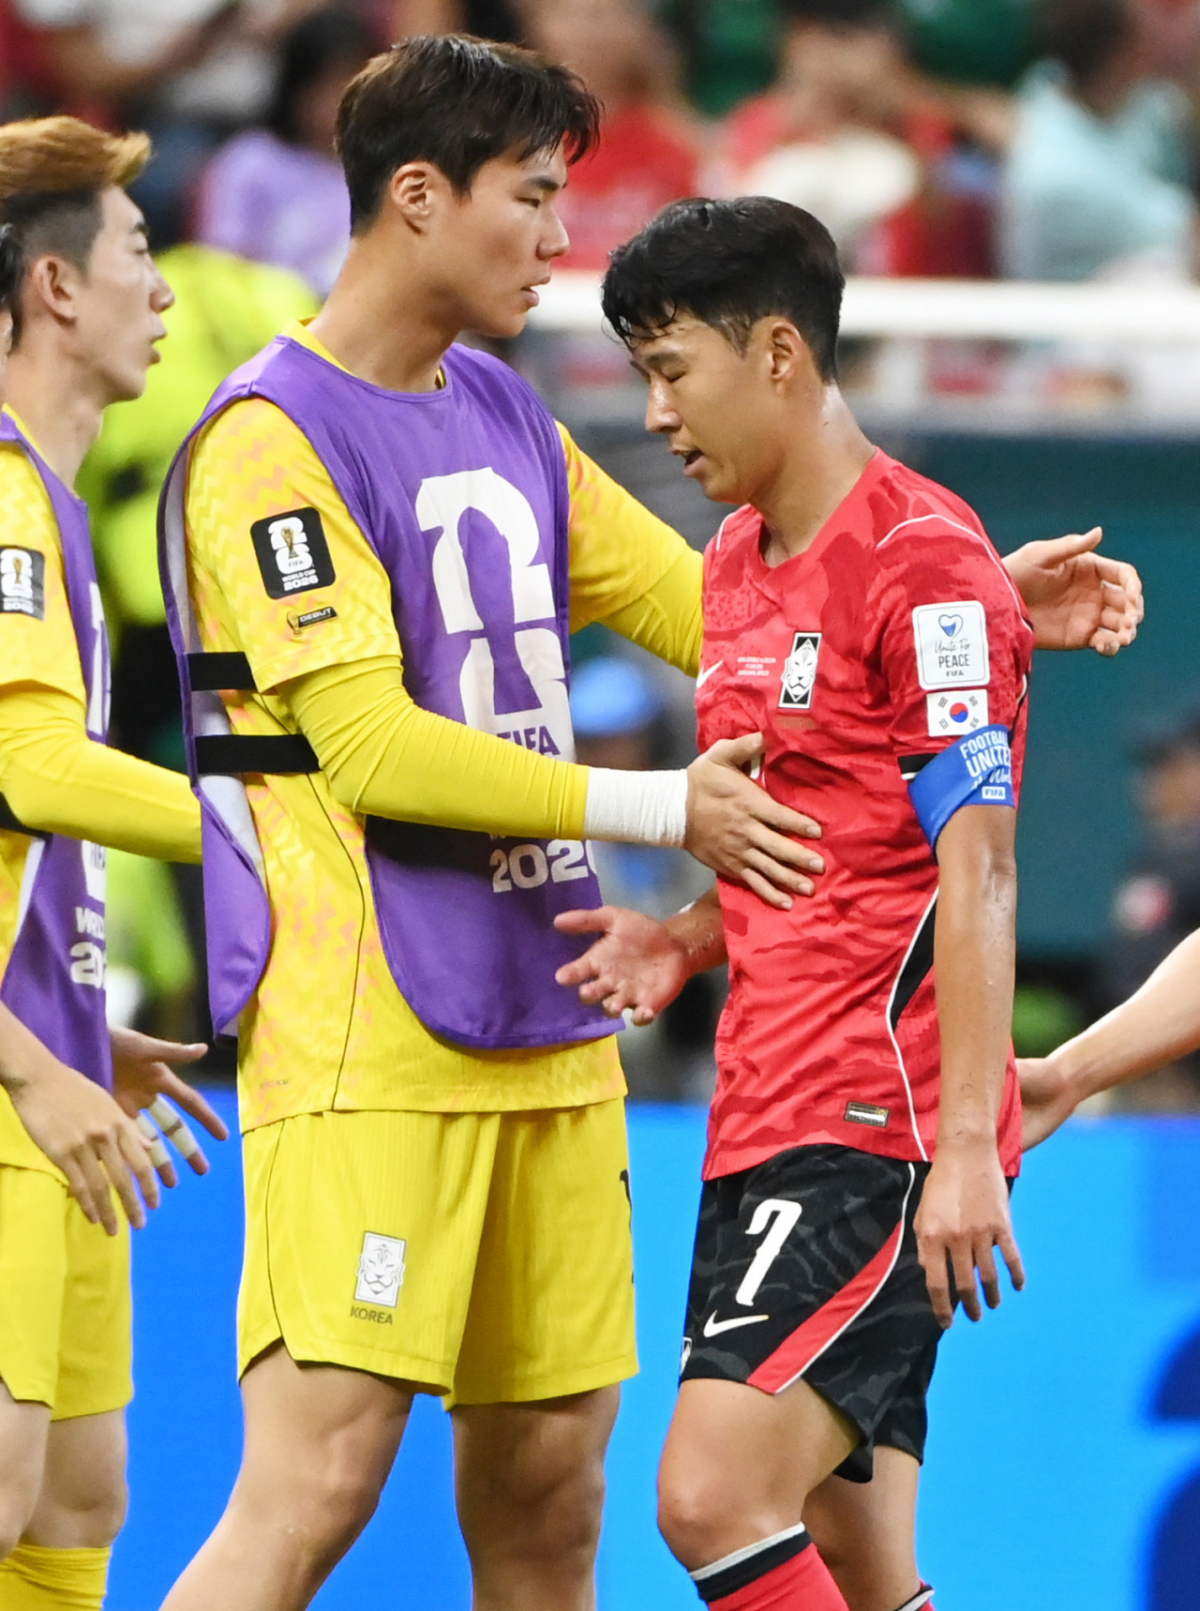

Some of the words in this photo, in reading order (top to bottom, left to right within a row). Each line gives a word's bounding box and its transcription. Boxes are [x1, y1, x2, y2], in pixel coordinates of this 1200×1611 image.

[284, 574, 319, 591] 2026
[299, 607, 331, 623] DEBUT
[938, 653, 971, 669] PEACE
[946, 669, 964, 678] FIFA
[985, 788, 1004, 797] FIFA
[490, 838, 598, 892] 202
[735, 1198, 803, 1307] 7
[350, 1305, 393, 1326] KOREA
